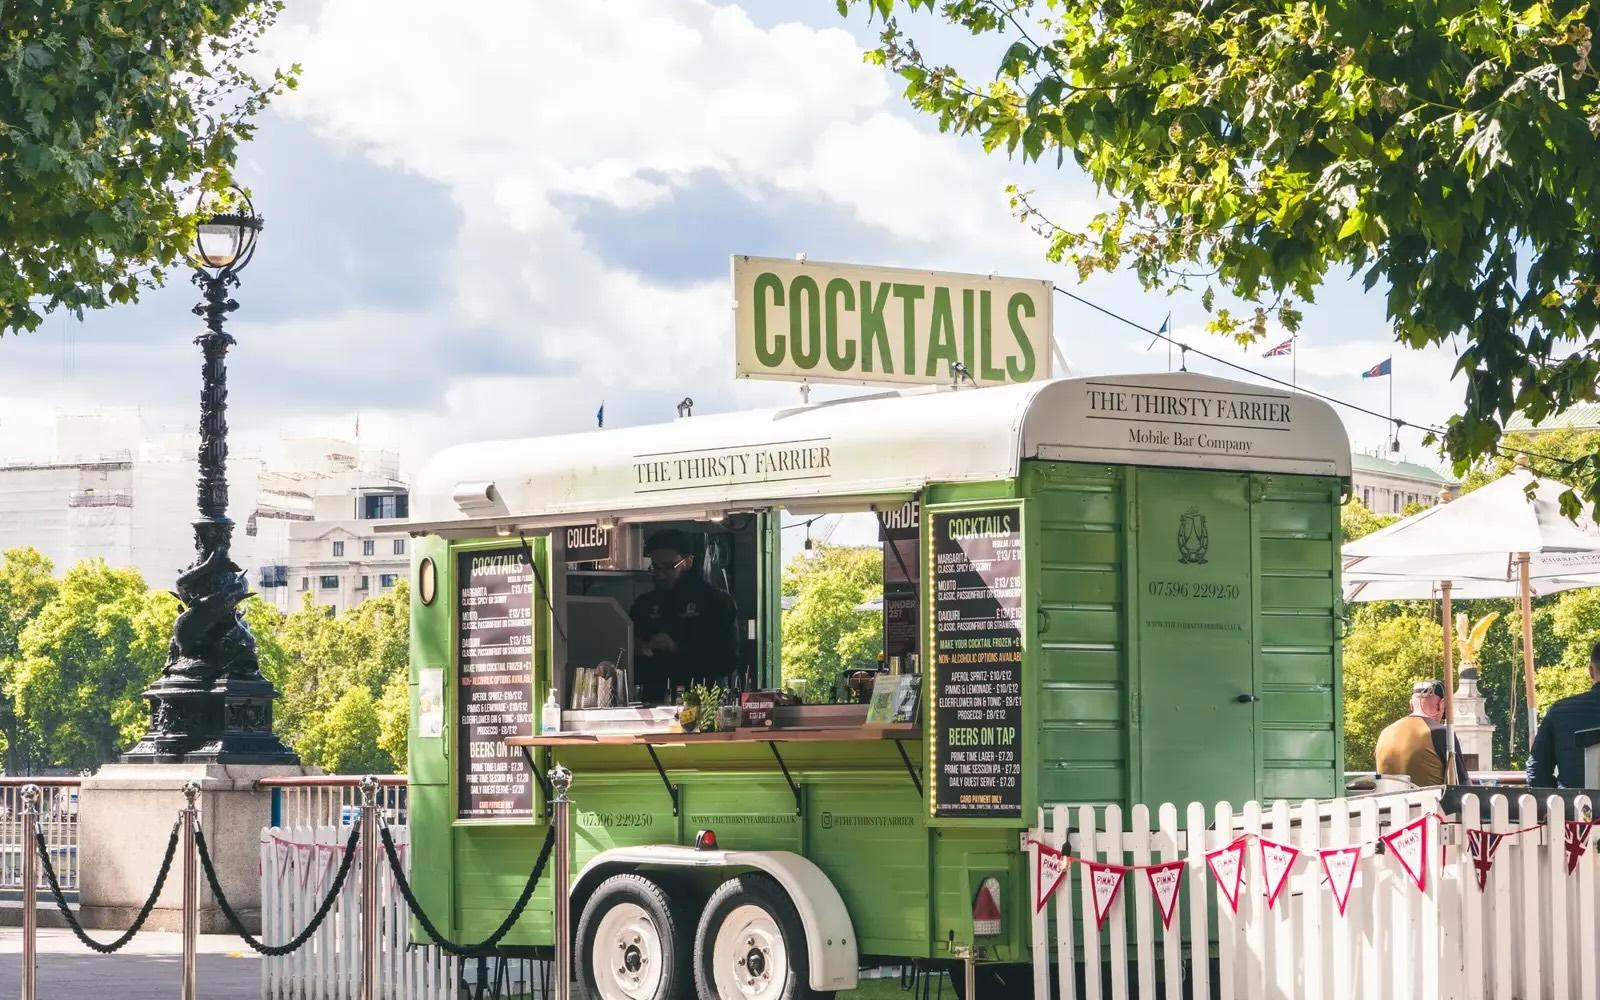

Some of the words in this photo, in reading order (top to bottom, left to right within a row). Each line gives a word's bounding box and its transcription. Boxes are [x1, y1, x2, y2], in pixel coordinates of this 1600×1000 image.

[754, 272, 1036, 383] COCKTAILS
[1087, 391, 1127, 412] THE
[1132, 394, 1211, 417] THIRSTY
[1217, 400, 1291, 422] FARRIER
[1129, 428, 1169, 445] Mobile
[1174, 432, 1194, 446] Bar
[1198, 434, 1252, 453] Company
[633, 461, 670, 484] THE
[674, 453, 750, 480] THIRSTY
[756, 446, 831, 474] FARRIER
[881, 501, 919, 529] ORDE
[949, 516, 1010, 540] COCKTAILS
[567, 526, 607, 548] COLLECT
[938, 553, 968, 564] MARGARITA
[472, 554, 523, 576] COCKTAILS
[957, 564, 968, 572] SPICY
[938, 580, 956, 590] MOJITO
[1148, 581, 1189, 598] 07596
[1193, 583, 1239, 600] 229250
[957, 590, 986, 600] PASSIONFRUIT
[938, 610, 960, 621] DAIQUIRI
[957, 621, 986, 631] PASSIONFRUIT
[987, 621, 993, 629] OR
[940, 640, 954, 649] MAKE
[954, 640, 967, 648] YOUR
[968, 639, 991, 648] COCKTAIL
[992, 638, 1011, 647] FROZEN
[951, 653, 977, 663] ALCOHOLIC
[978, 653, 998, 662] OPTIONS
[487, 663, 506, 672] COCKTAIL
[507, 662, 522, 670] FROZEN
[951, 672, 969, 681] APEROL
[945, 685, 960, 694] PIMMS
[966, 684, 992, 694] LEMONADE
[940, 698, 972, 707] ELDERFLOWER
[988, 697, 1001, 706] TONIC
[1006, 697, 1022, 706] £8/£1
[958, 710, 982, 720] PROSECCO
[477, 726, 498, 735] PROSECCO
[949, 728, 978, 745] BEERS
[981, 727, 993, 745] ON
[996, 727, 1015, 745] TAP
[470, 742, 495, 757] BEERS
[497, 742, 507, 757] ON
[951, 752, 965, 761] PRIME
[966, 752, 977, 761] TIME
[978, 752, 994, 761] LAGER
[998, 752, 1013, 760] £7.20
[945, 764, 958, 774] PRIME
[960, 764, 971, 774] TIME
[972, 764, 992, 774] SESSION
[1005, 764, 1020, 774] £7.20
[949, 777, 962, 786] DAILY
[964, 777, 979, 786] GUEST
[980, 777, 995, 786] SERVE
[1000, 777, 1015, 786] £7.20
[583, 814, 613, 827] 07596
[616, 814, 652, 827] 229250
[1398, 832, 1420, 849] PIMM'S
[1043, 858, 1061, 873] PIMM'S
[1097, 874, 1115, 886] PIMM'S
[1156, 872, 1176, 886] PIMM'S
